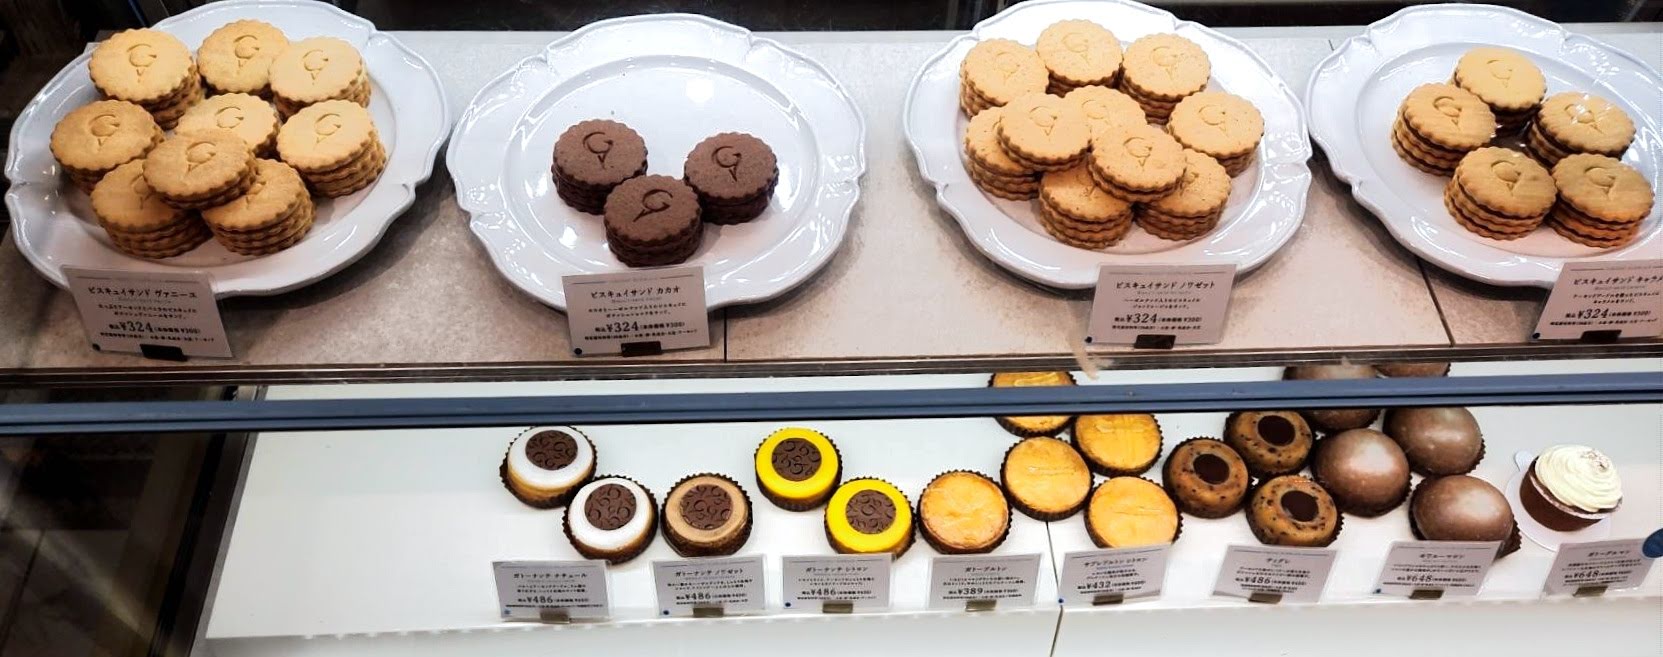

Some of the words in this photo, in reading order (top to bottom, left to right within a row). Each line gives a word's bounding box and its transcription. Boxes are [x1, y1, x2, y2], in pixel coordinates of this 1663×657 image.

[1116, 281, 1177, 290] ビスキュイサンド
[1180, 281, 1215, 290] ノワゼット
[1574, 276, 1634, 286] ビスキュイサンド
[88, 286, 150, 298] ビスキュイサンド
[155, 289, 198, 299] ヴァニーユ
[590, 286, 652, 299] ビスキュイサンド
[657, 285, 681, 295] カカオ
[1126, 312, 1159, 324] ¥324
[1577, 308, 1610, 320] ¥324
[120, 321, 154, 333] ¥324
[606, 321, 639, 333] ¥324
